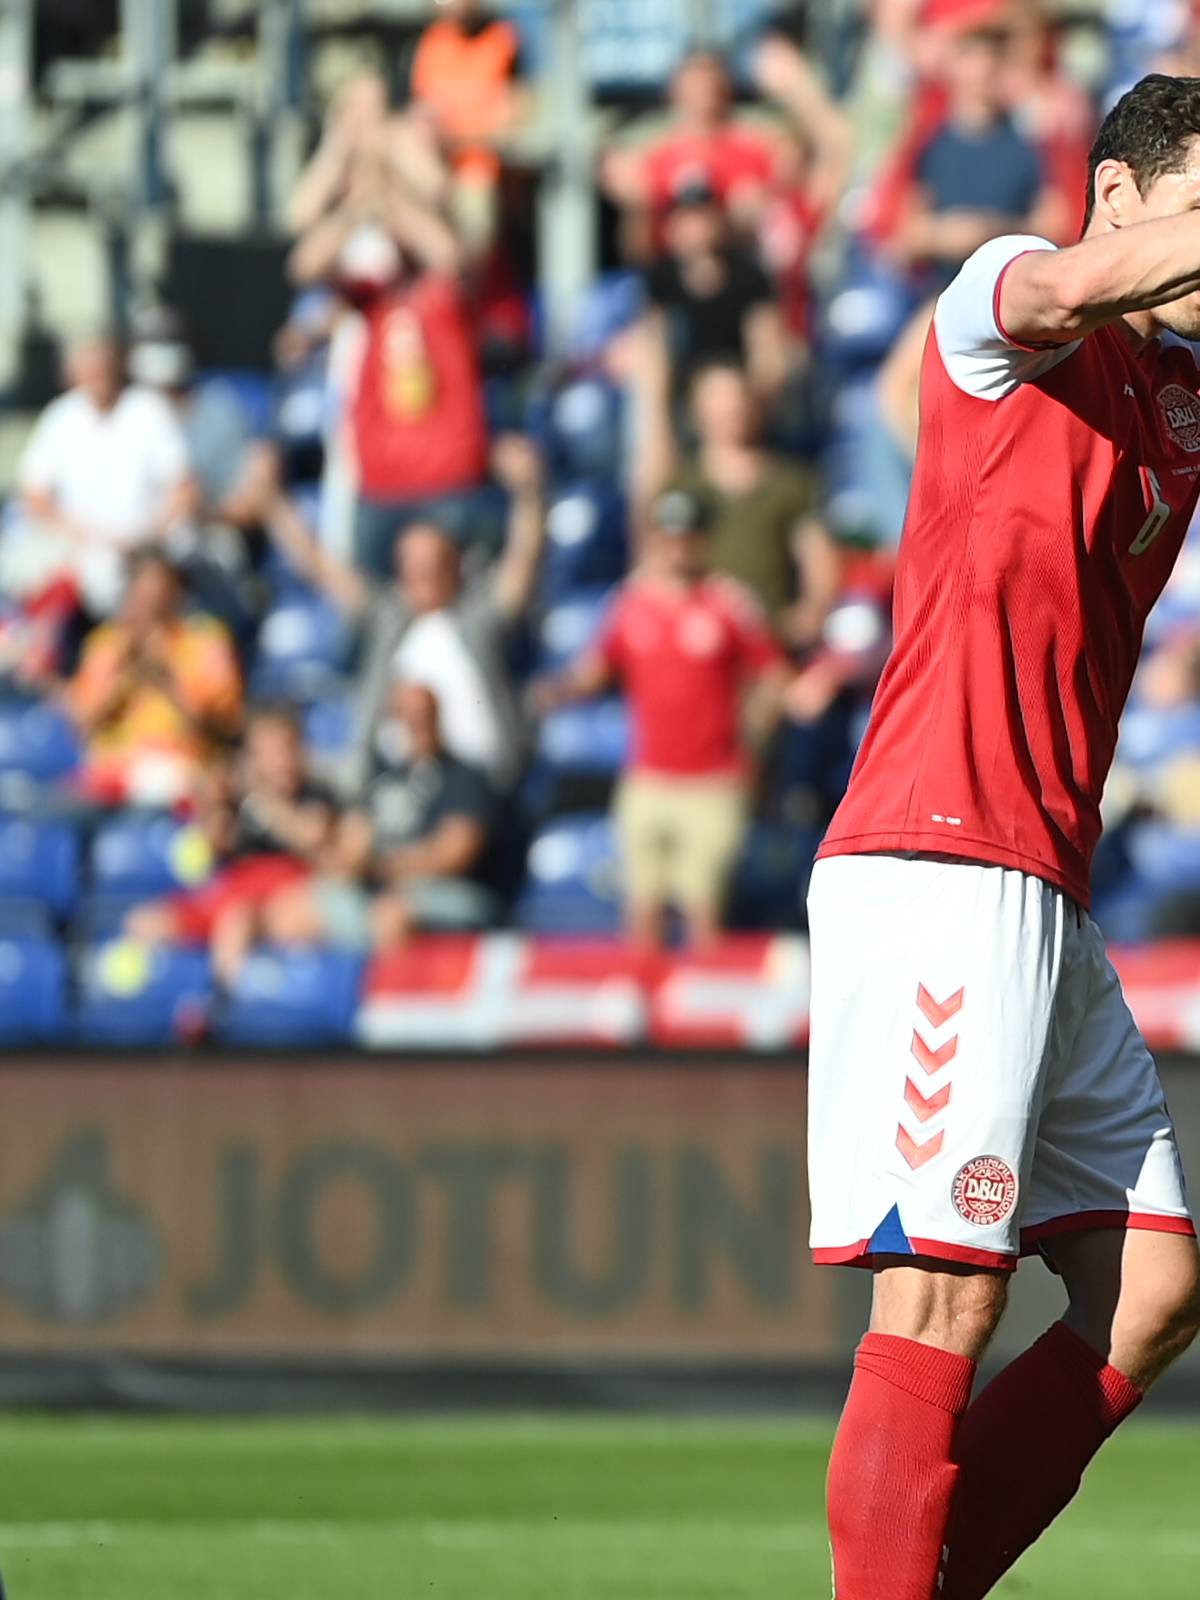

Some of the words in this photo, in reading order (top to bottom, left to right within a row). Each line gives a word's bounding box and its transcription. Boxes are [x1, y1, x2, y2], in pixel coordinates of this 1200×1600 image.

[1167, 407, 1196, 429] DBU
[965, 1178, 1004, 1202] DBU
[187, 1138, 800, 1320] JOTUN
